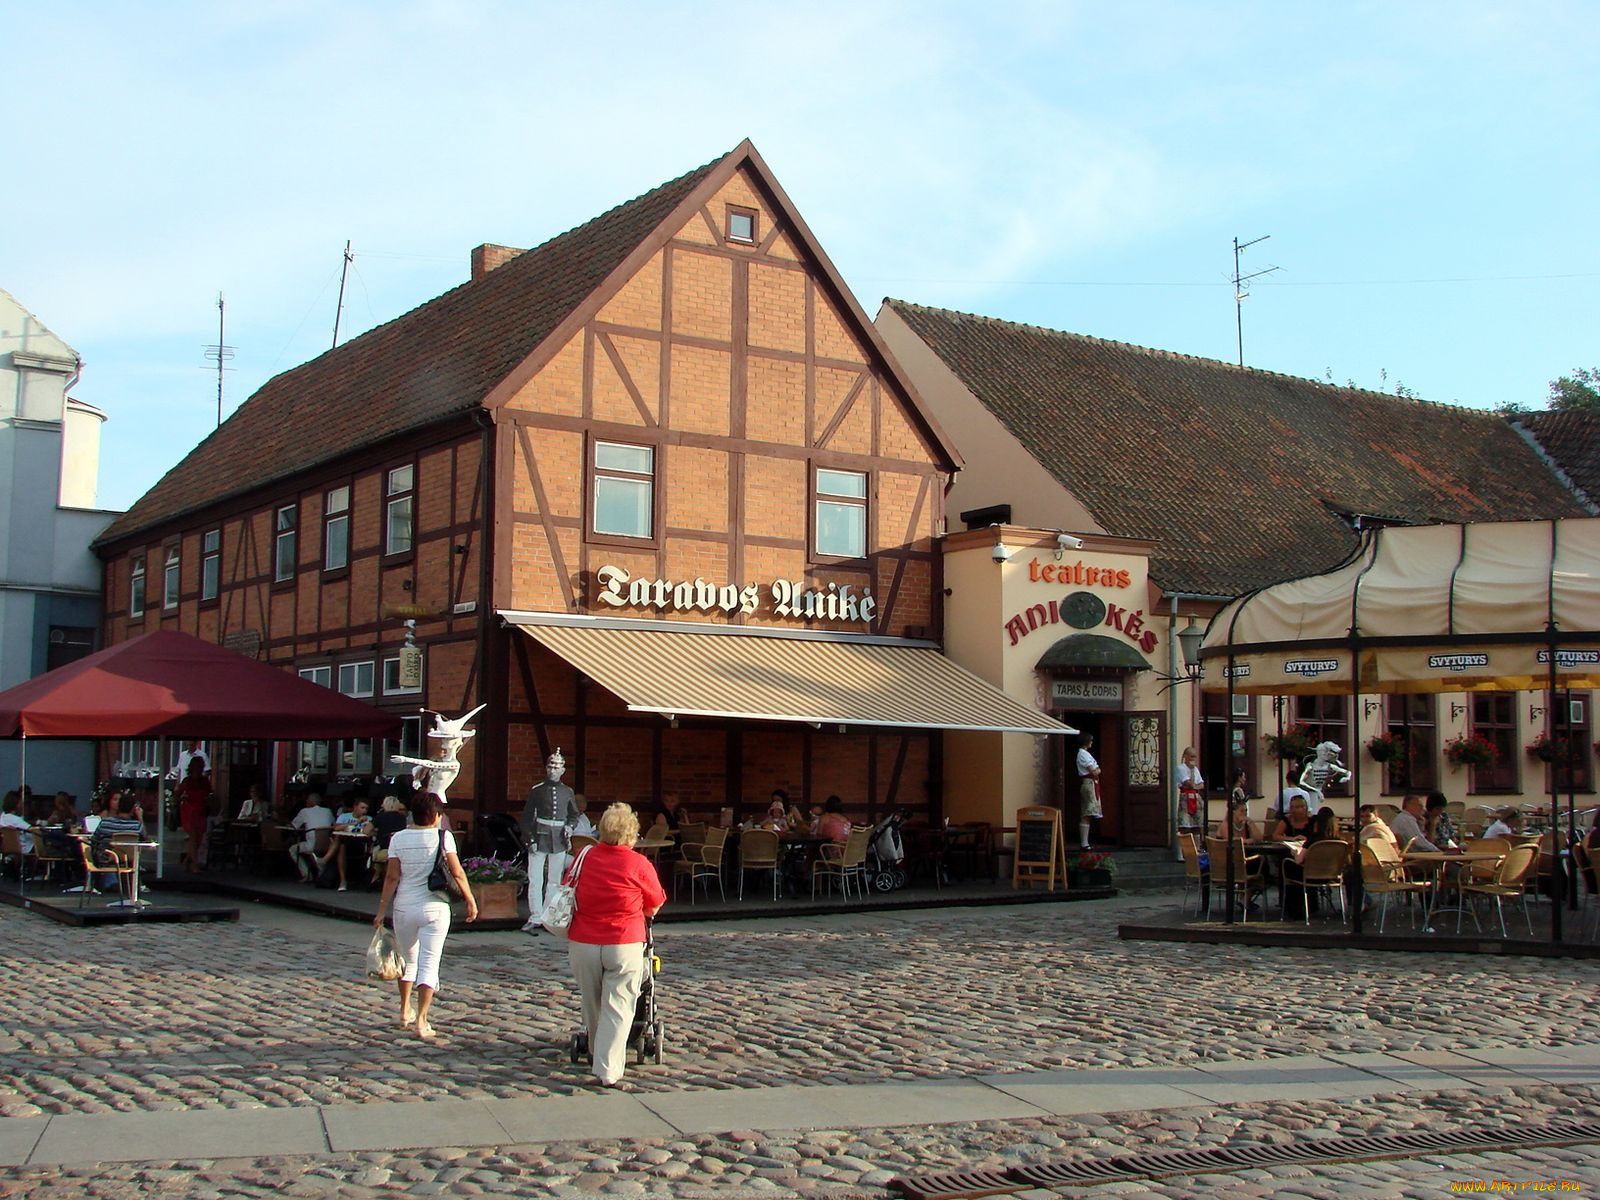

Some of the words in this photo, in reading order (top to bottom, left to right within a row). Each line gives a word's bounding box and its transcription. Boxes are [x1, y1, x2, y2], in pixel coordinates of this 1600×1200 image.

[1029, 557, 1131, 589] teatras
[597, 565, 759, 615] Taravos
[1057, 684, 1082, 696] TAPAS
[1083, 682, 1090, 697] &
[1092, 685, 1118, 697] COPAS
